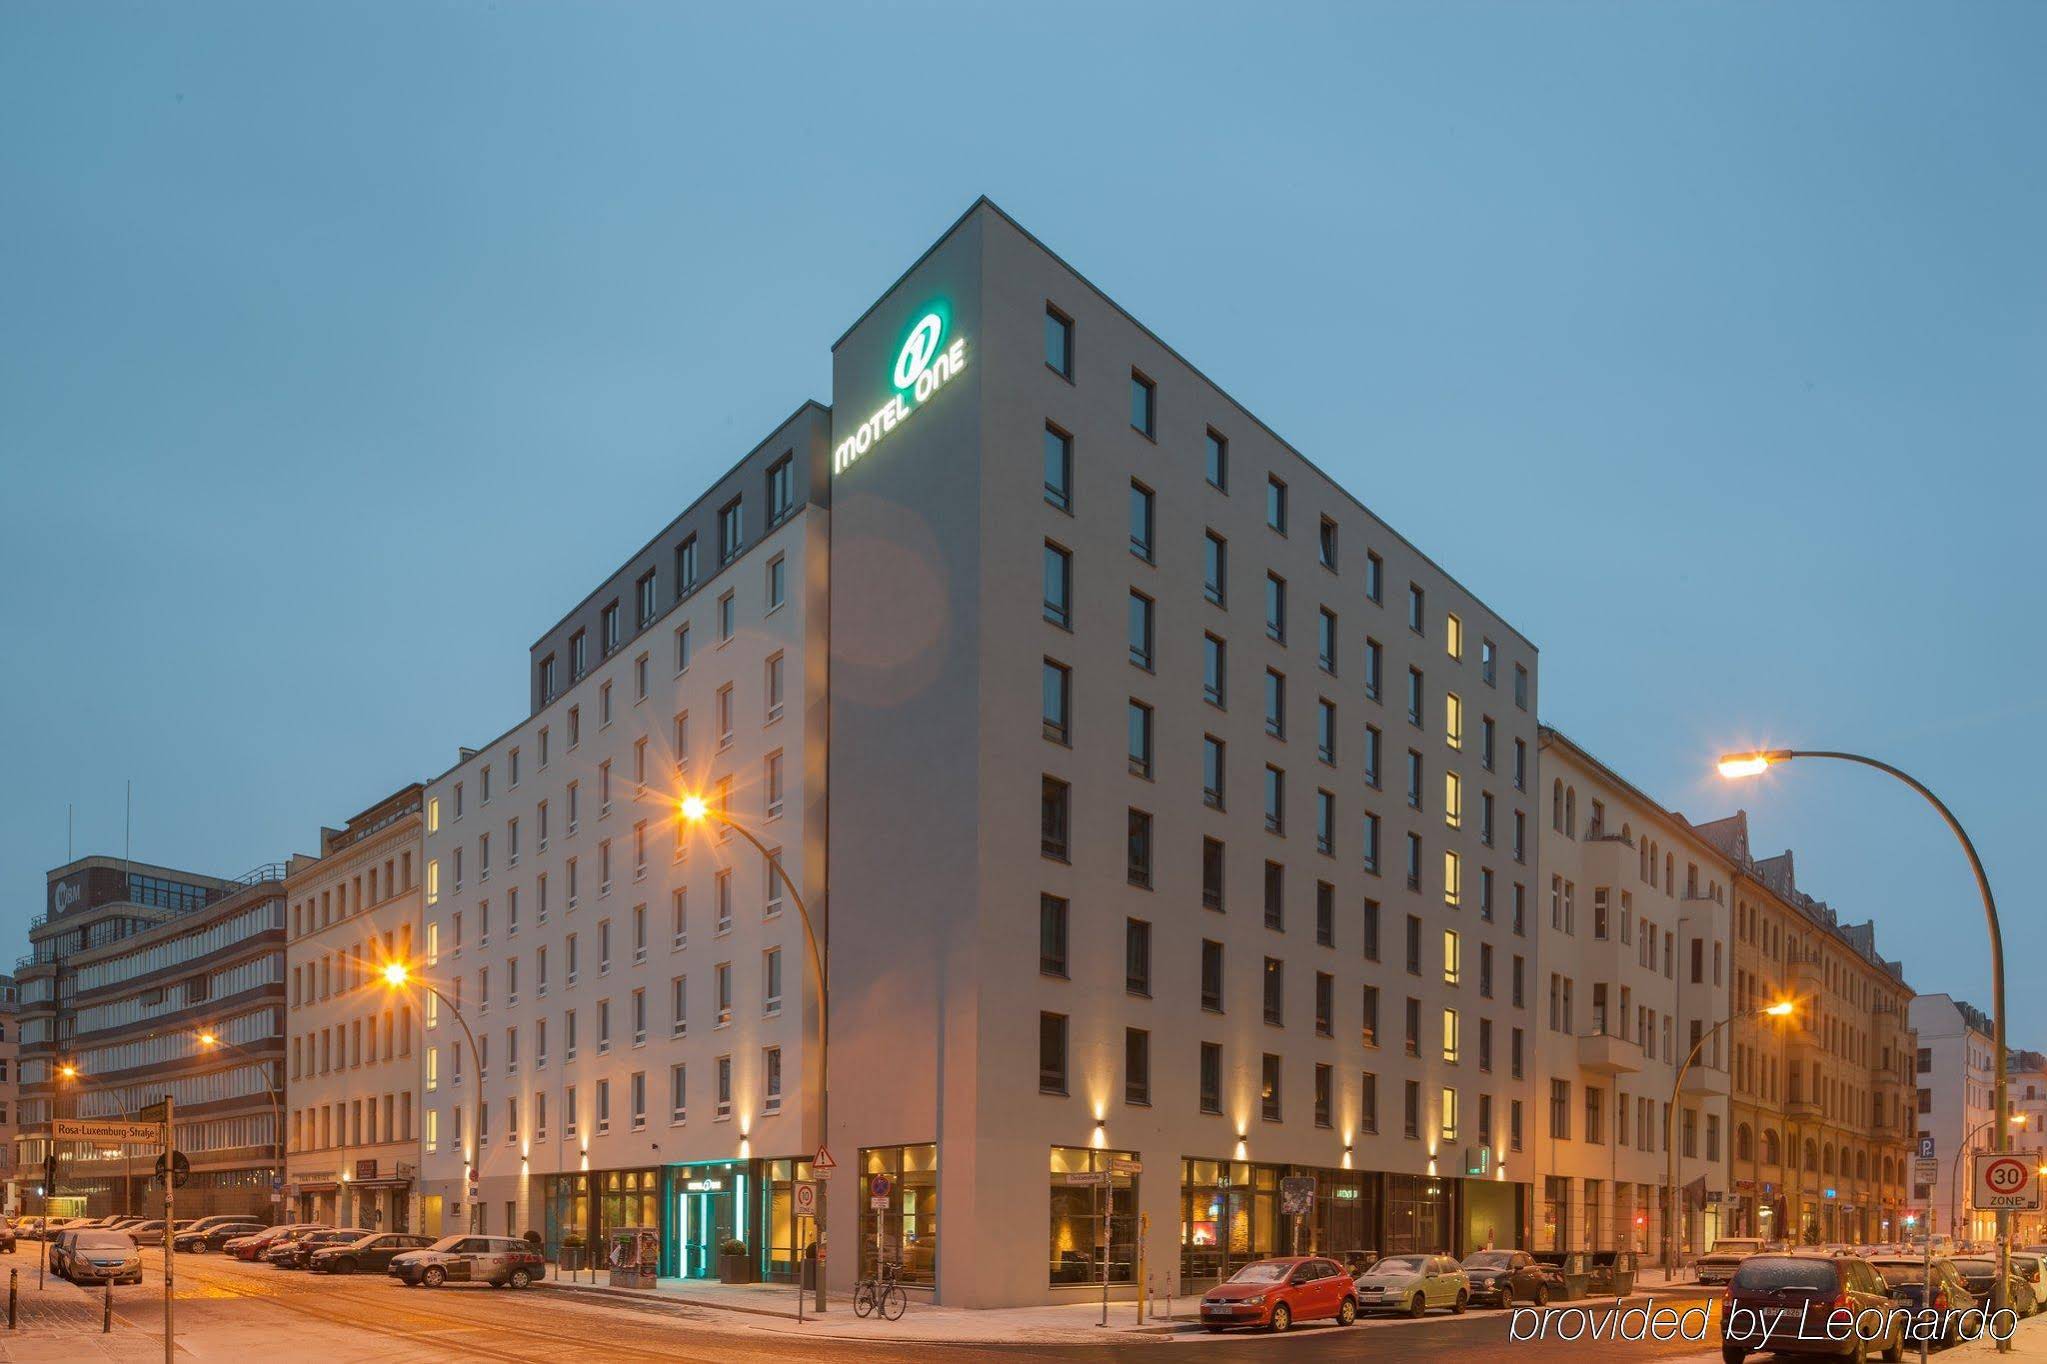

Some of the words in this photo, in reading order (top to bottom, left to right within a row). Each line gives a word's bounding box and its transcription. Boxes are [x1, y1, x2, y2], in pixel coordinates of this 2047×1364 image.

[834, 393, 909, 474] MOTEL
[915, 338, 968, 402] ONE
[58, 1123, 155, 1139] Rosa-Luxemburg-Straße
[1994, 1168, 2019, 1185] 30
[1990, 1196, 2021, 1206] ZONE
